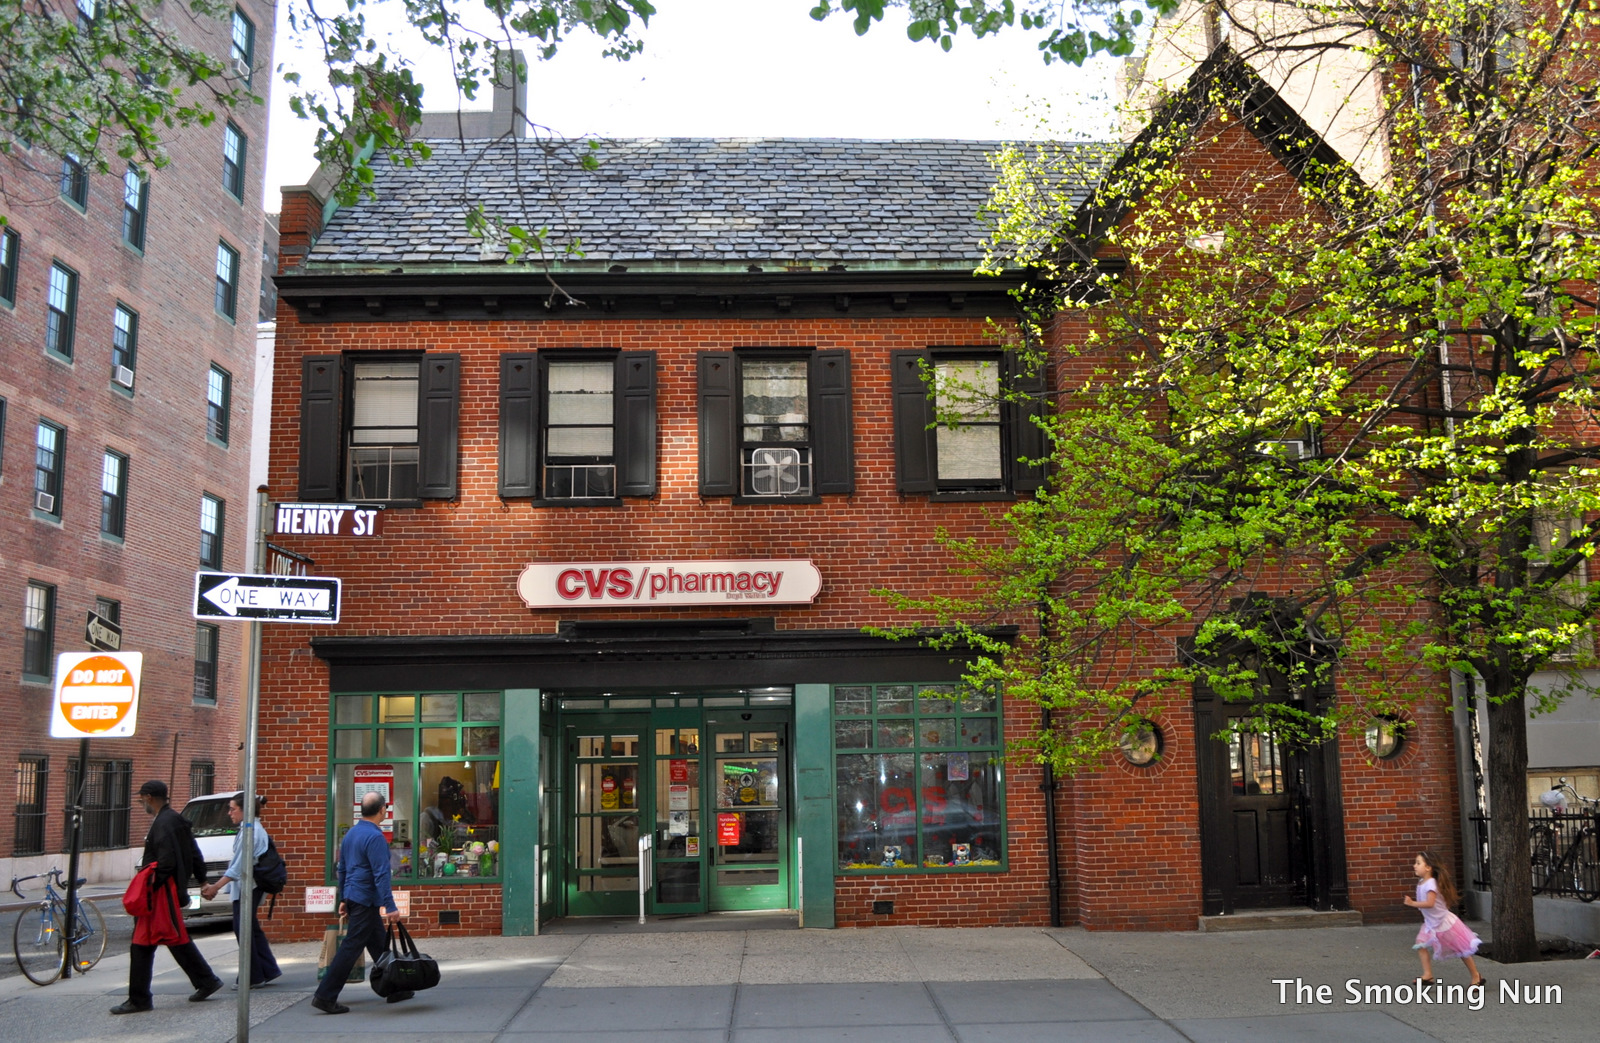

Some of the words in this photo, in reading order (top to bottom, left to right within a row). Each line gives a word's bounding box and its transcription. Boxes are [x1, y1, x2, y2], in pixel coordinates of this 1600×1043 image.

[277, 508, 344, 535] HENRY
[353, 509, 378, 536] ST
[271, 552, 293, 576] LOVE
[555, 566, 784, 600] CVS/pharmacy
[220, 588, 259, 606] ONE
[279, 591, 320, 608] WAY
[91, 622, 102, 640] ONE
[106, 631, 119, 646] WAY
[72, 669, 94, 684] DO
[95, 669, 126, 684] NOT
[71, 705, 118, 720] ENTER
[880, 786, 948, 813] CVS
